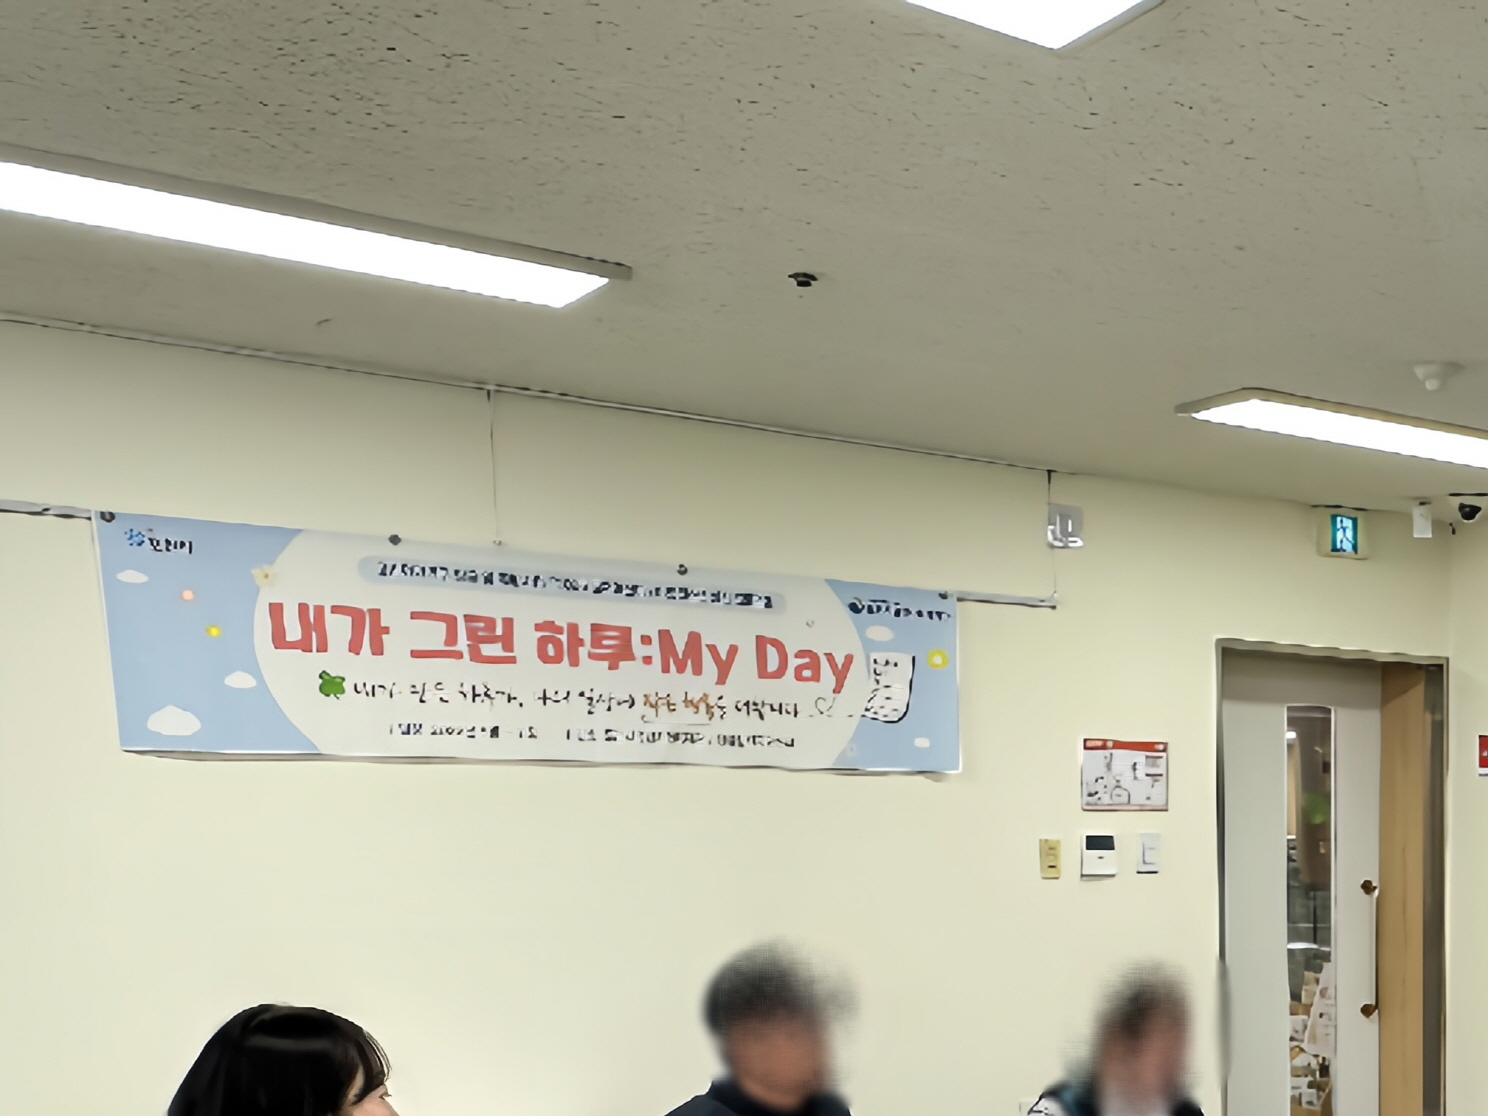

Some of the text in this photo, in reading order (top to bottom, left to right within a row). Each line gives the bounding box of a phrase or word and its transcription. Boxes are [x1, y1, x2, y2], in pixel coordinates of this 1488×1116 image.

[268, 602, 390, 656] 내가
[410, 611, 517, 664] 그린
[755, 634, 854, 694] Day
